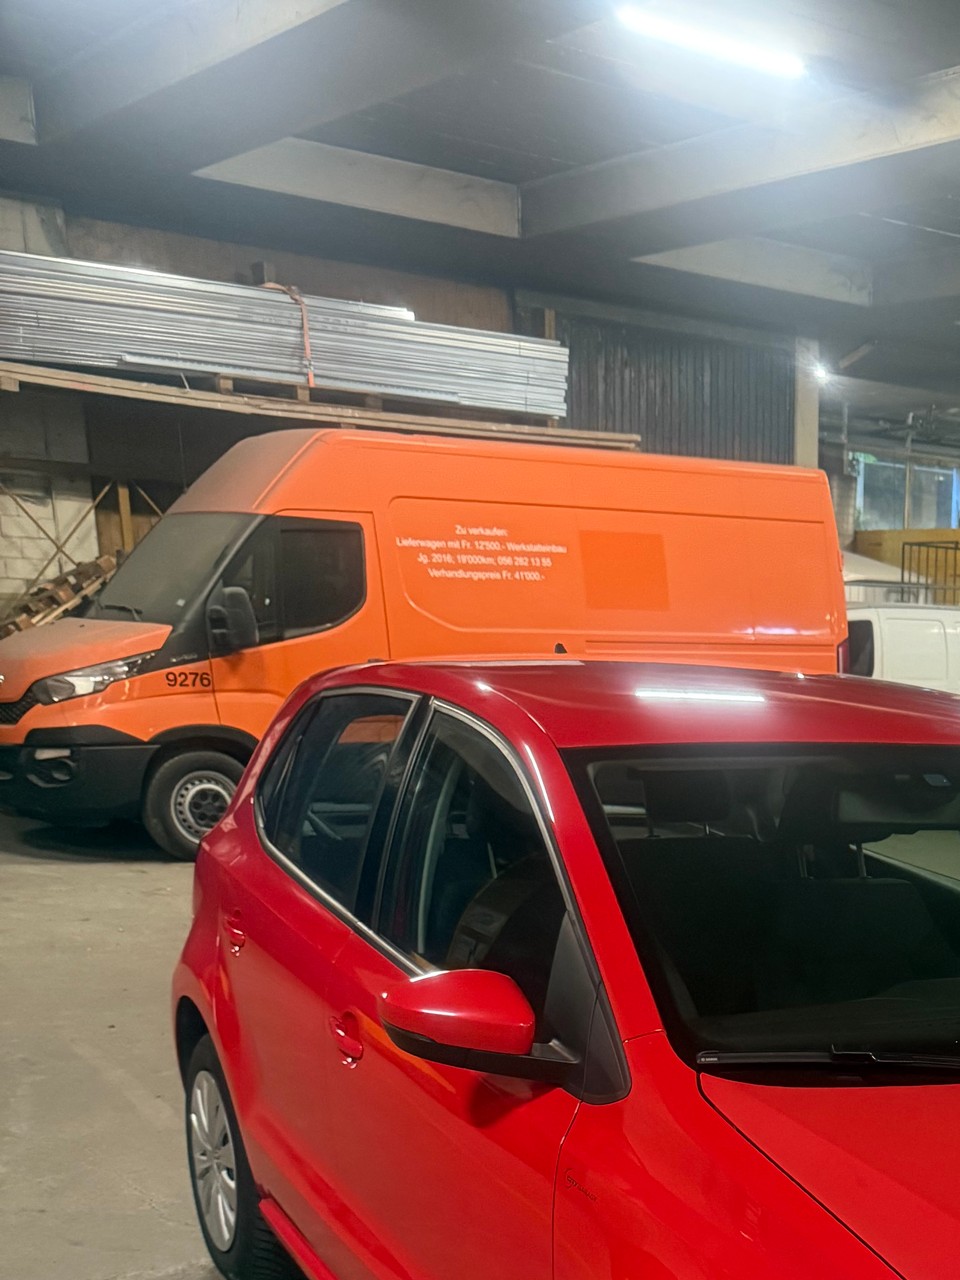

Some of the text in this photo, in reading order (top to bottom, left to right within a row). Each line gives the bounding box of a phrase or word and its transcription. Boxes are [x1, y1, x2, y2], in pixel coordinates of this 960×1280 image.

[455, 524, 467, 535] Zu
[396, 537, 446, 549] Lieferwagen
[447, 540, 460, 549] mit
[461, 539, 472, 550] Fr.
[417, 552, 430, 564] Jg.
[428, 568, 501, 580] Verhandlungspreis
[165, 671, 211, 687] 9276
